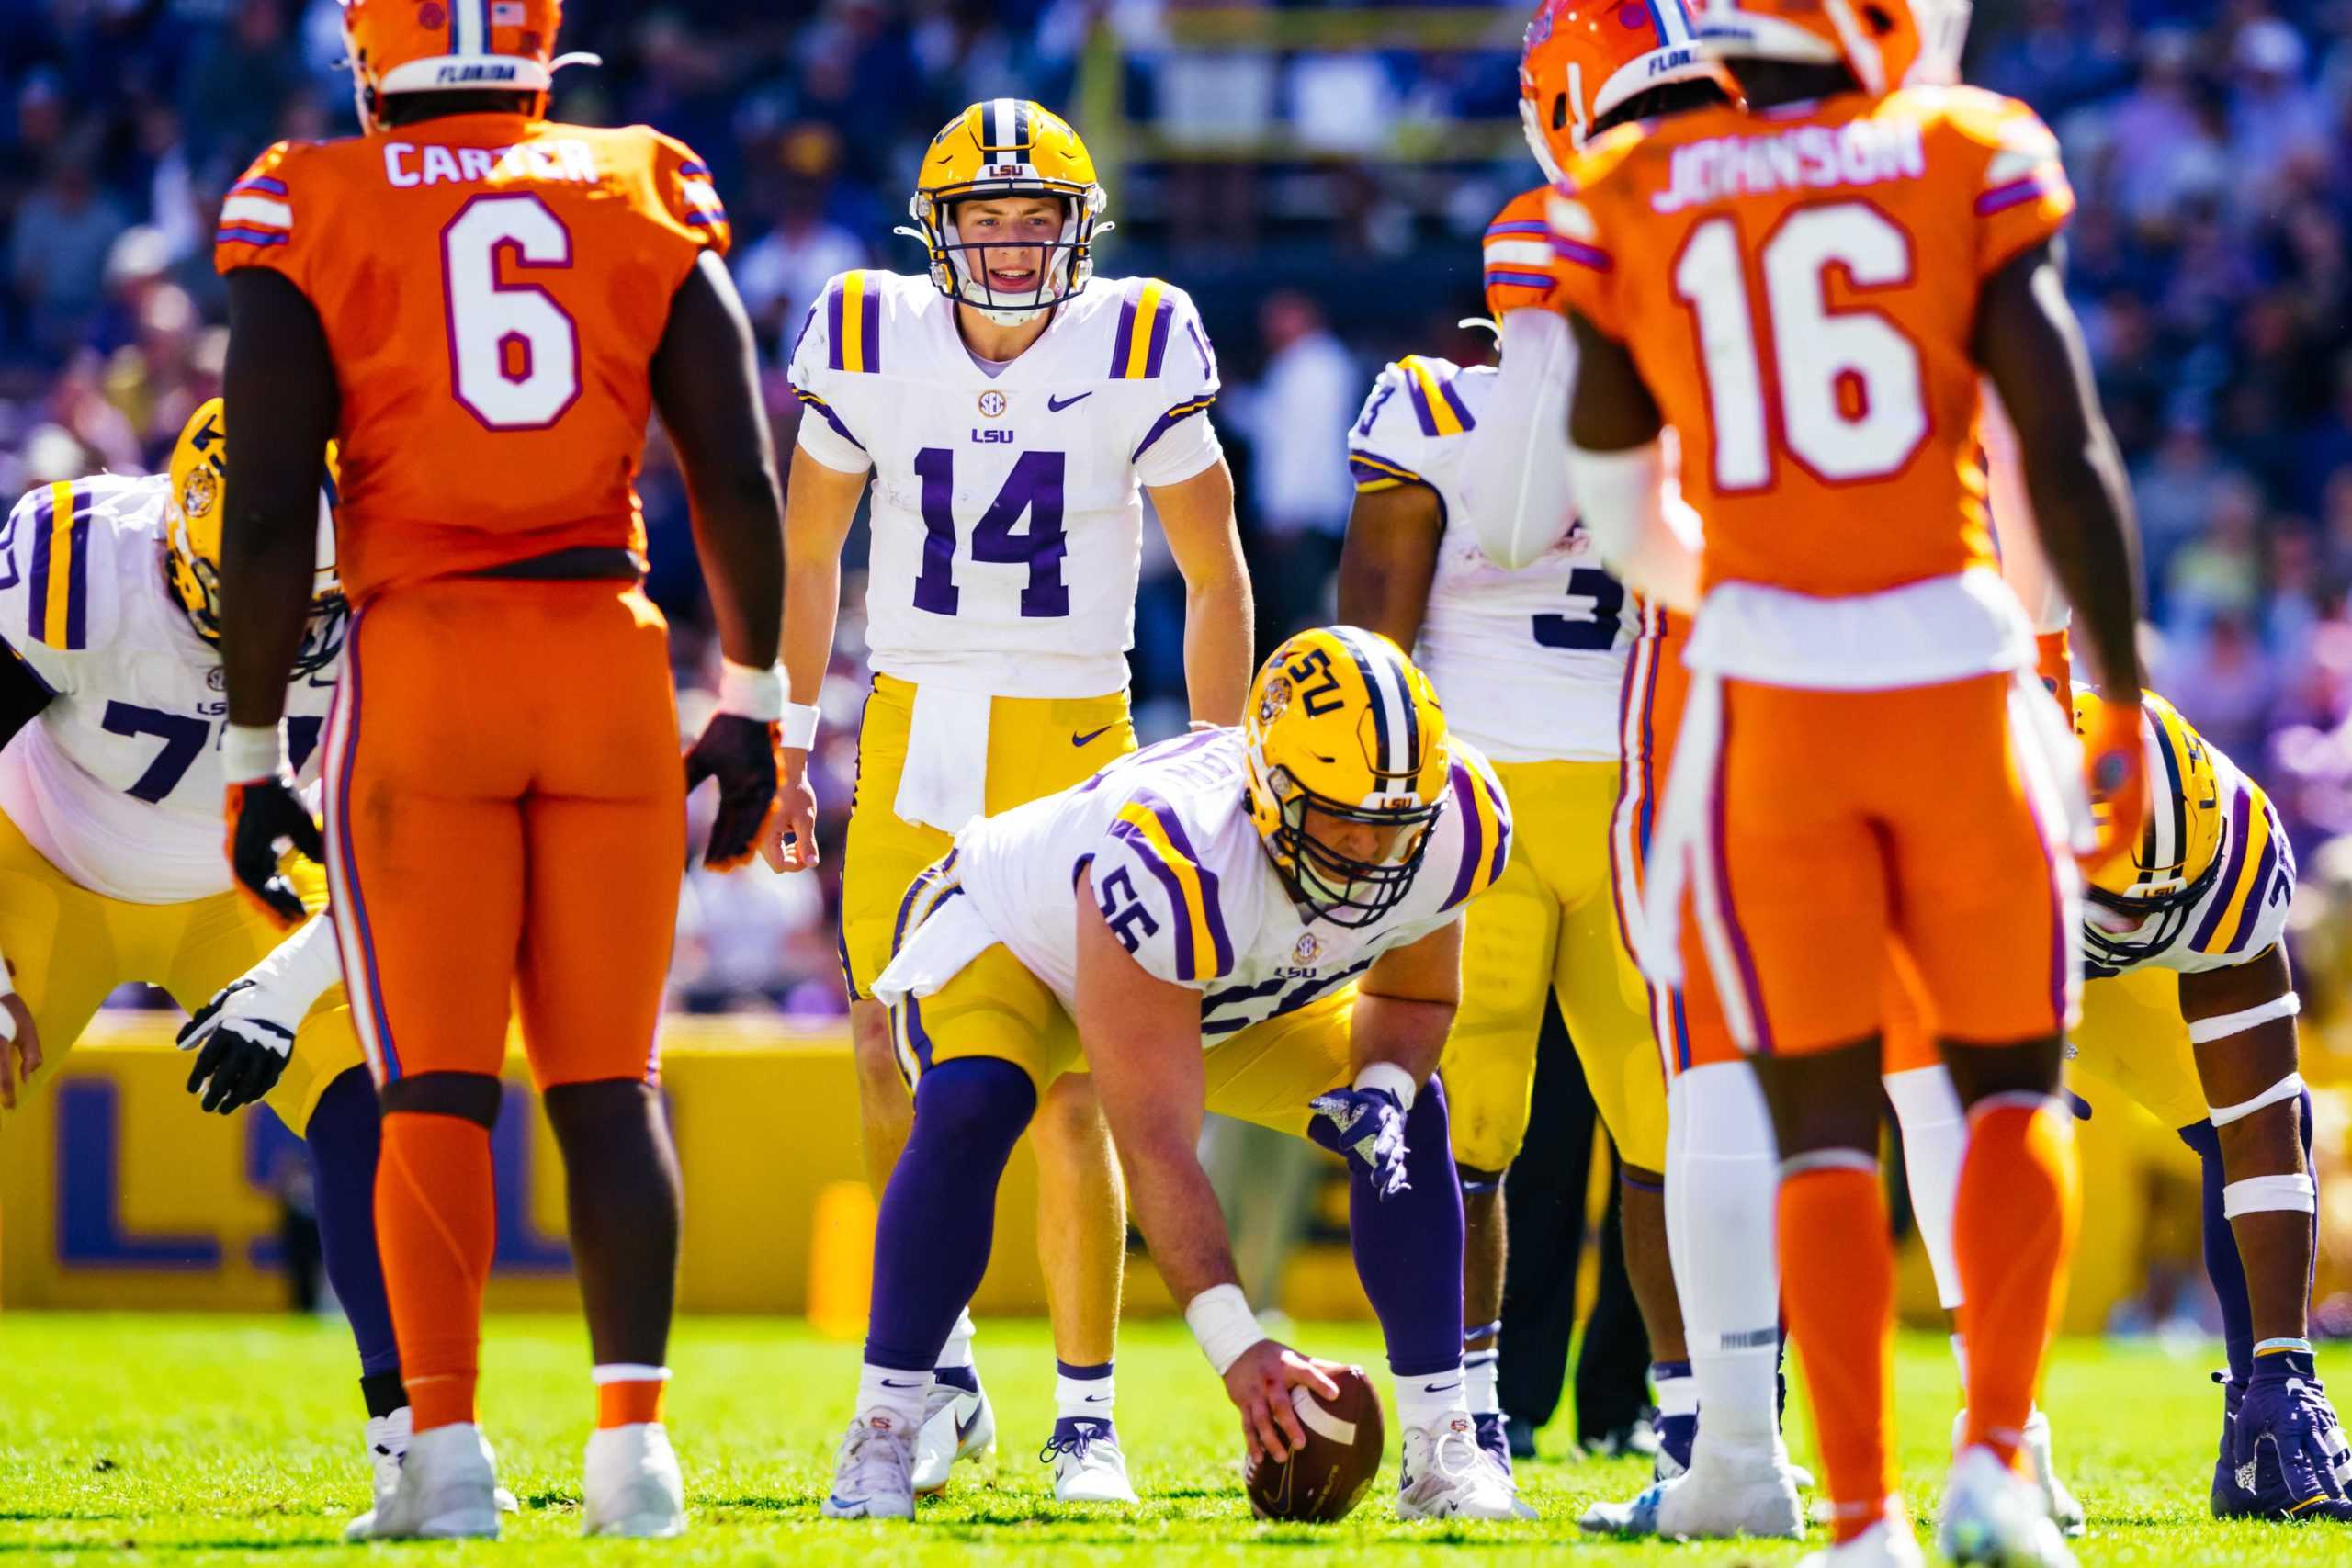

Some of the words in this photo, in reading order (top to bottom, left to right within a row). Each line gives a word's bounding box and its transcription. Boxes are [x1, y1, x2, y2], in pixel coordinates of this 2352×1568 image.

[1648, 49, 1692, 77] FLOR
[384, 140, 599, 187] CARTER
[989, 165, 1023, 177] LSU
[1651, 118, 1925, 213] JOHNSON
[440, 191, 582, 432] 6
[1674, 198, 1931, 497] 16
[971, 428, 1014, 444] LSU
[912, 447, 1069, 618] 14
[1532, 567, 1625, 651] 3
[196, 702, 227, 716] LS
[1274, 966, 1317, 980] LSU
